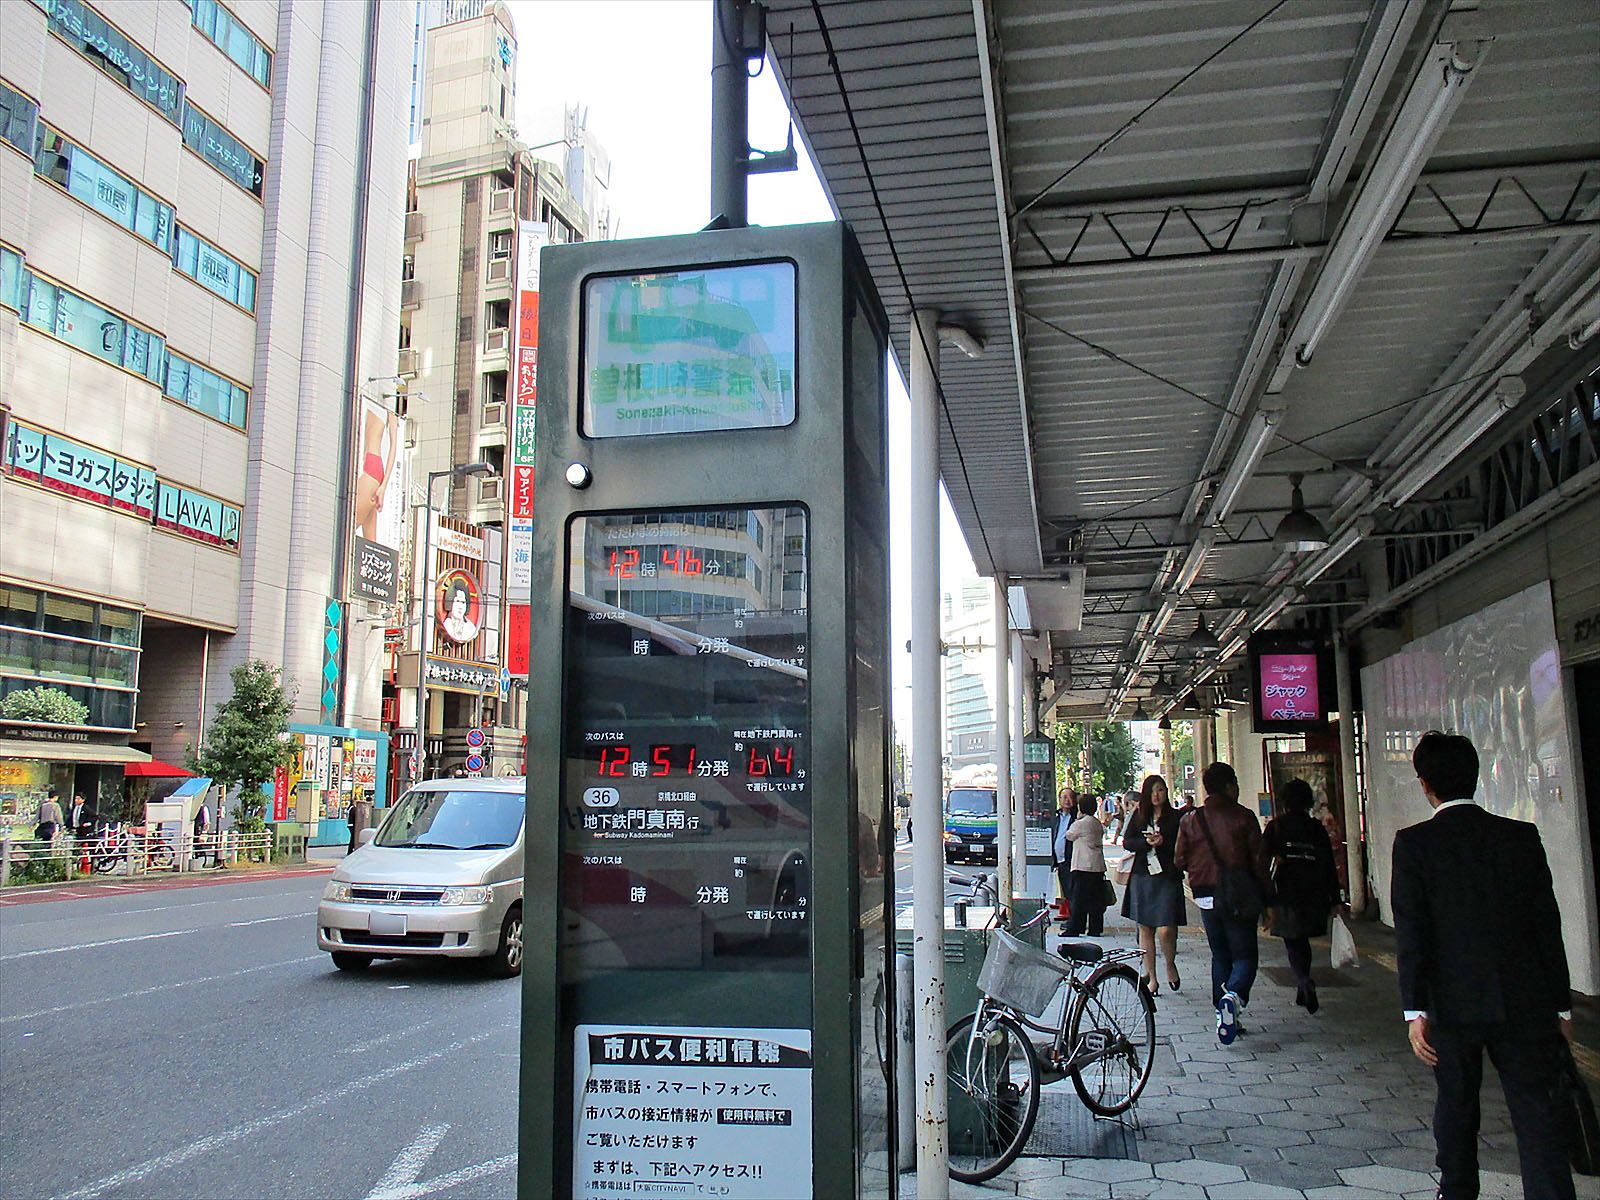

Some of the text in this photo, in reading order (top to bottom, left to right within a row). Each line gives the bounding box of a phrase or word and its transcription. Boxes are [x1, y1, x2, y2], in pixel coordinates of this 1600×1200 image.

[520, 478, 530, 515] アイフル
[165, 493, 213, 531] LAVA
[361, 552, 392, 572] リズミック
[515, 549, 529, 563] 海
[587, 611, 625, 620] 次のバスは
[633, 638, 729, 655] 時 分発
[1265, 685, 1307, 698] ジャック
[1285, 699, 1295, 708] &
[585, 732, 624, 741] 次のバスは
[734, 743, 743, 752] 約
[797, 769, 806, 778] 分
[746, 782, 805, 792] で運行しています
[592, 790, 611, 804] 36
[584, 809, 700, 830] 地下鉄門真南行
[629, 831, 674, 839] Kadomaminami
[583, 856, 622, 865] 次のバスは
[734, 868, 743, 877] 約
[630, 887, 729, 903] 時 分発
[798, 896, 807, 906] 分
[746, 911, 806, 920] で運行しています
[603, 1037, 781, 1063] 市バス便利情報
[585, 1105, 785, 1123] 市バスの接近情報が 使用料無料で
[585, 1133, 698, 1149] ご覧いただけます
